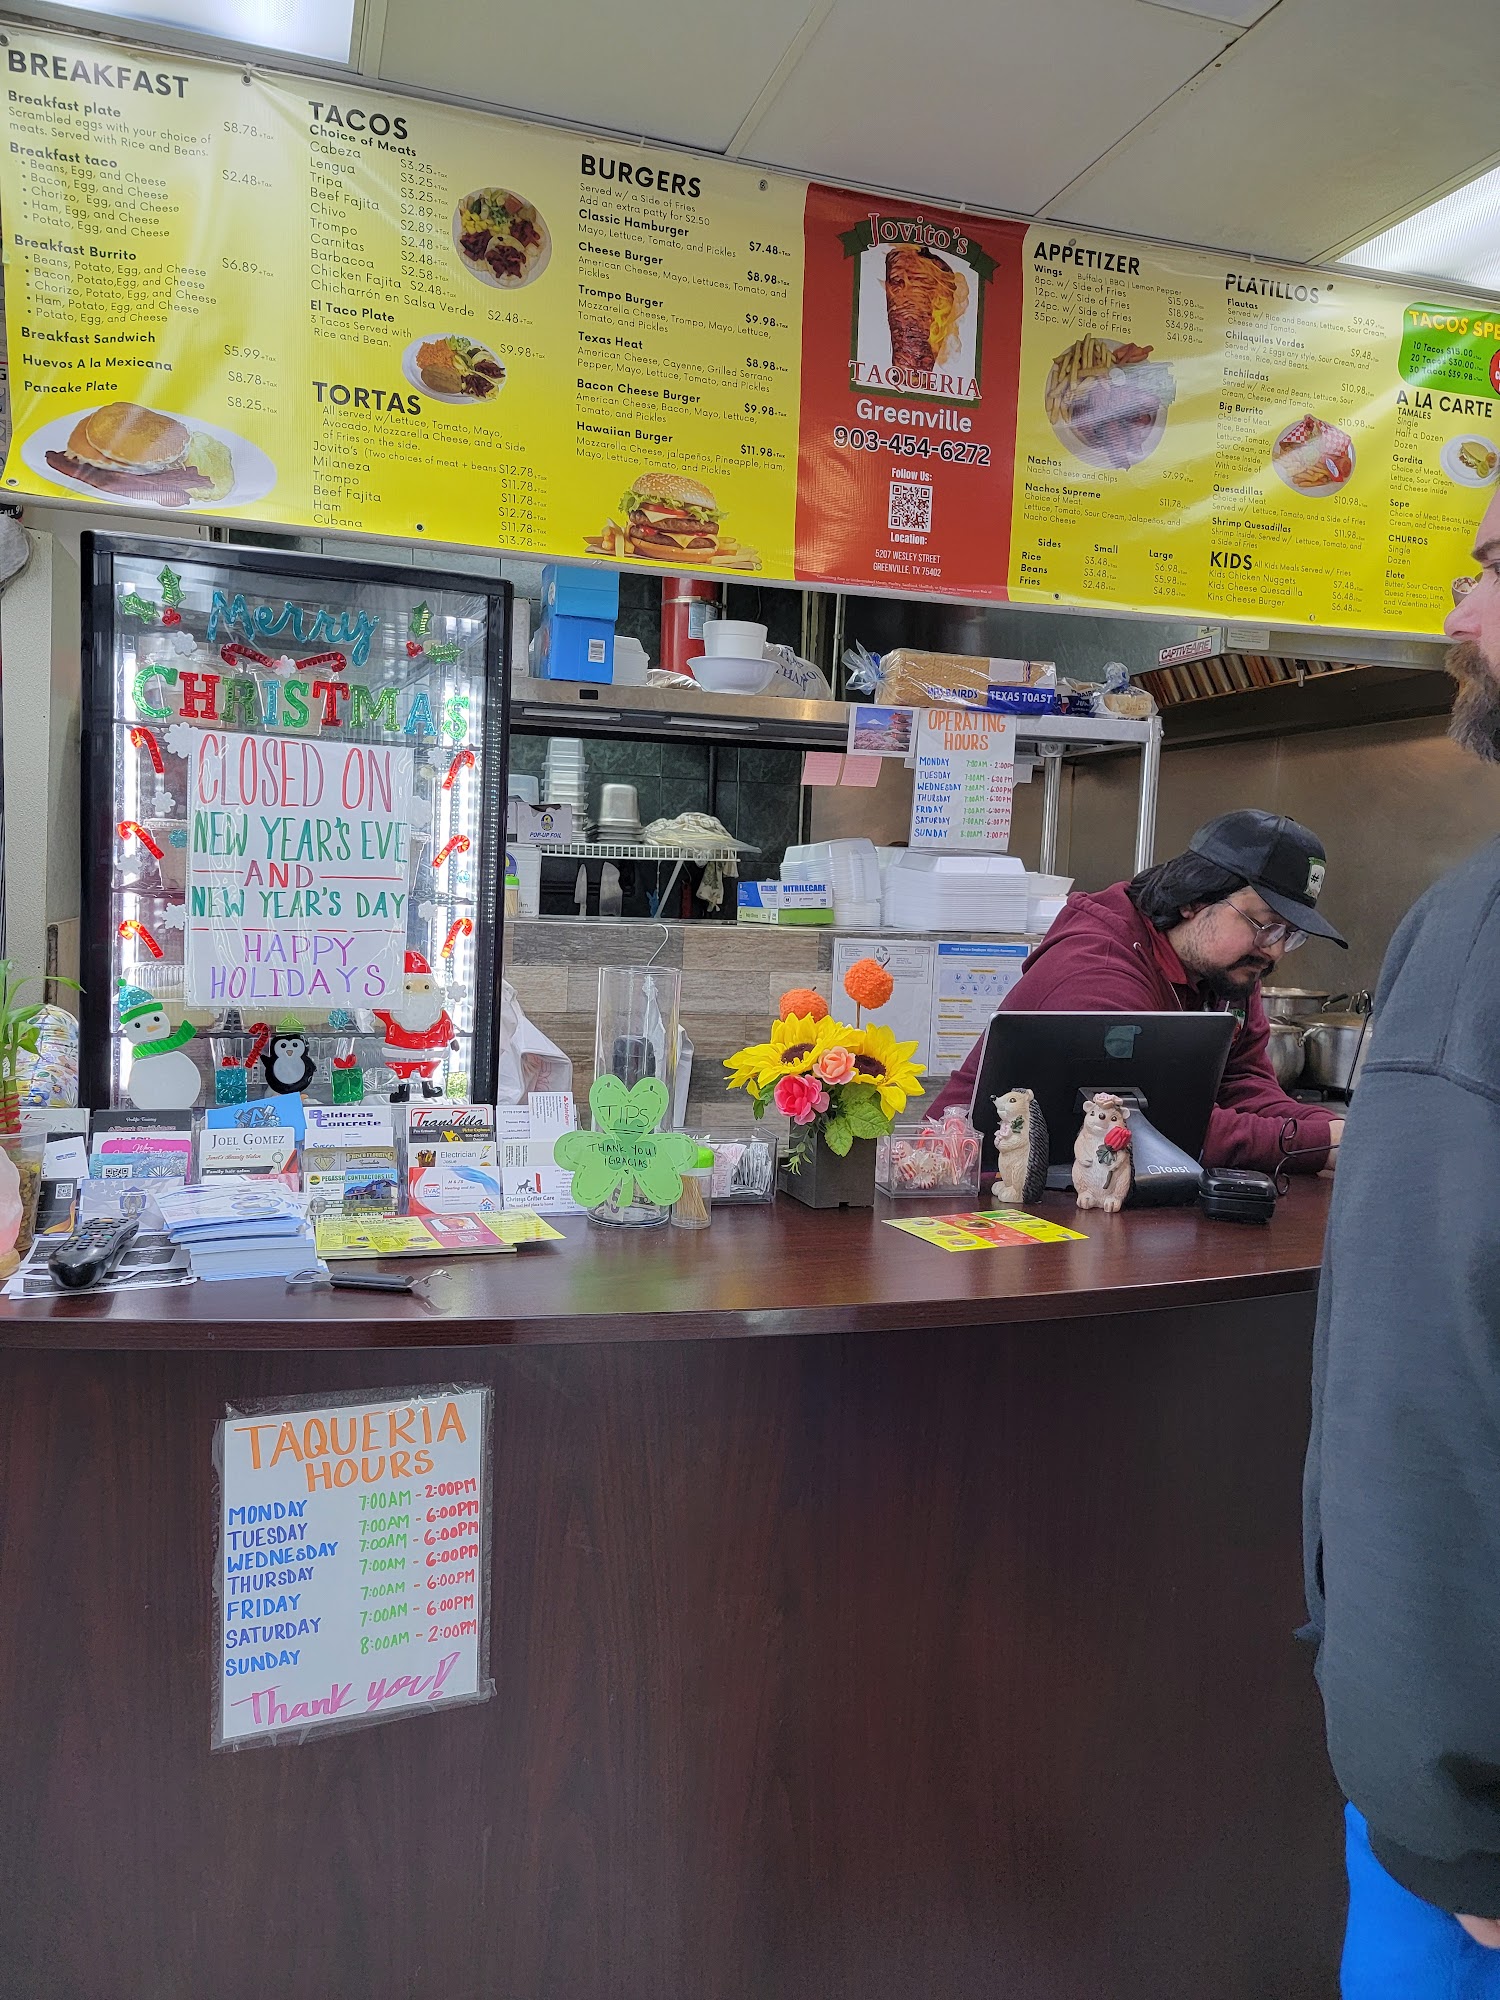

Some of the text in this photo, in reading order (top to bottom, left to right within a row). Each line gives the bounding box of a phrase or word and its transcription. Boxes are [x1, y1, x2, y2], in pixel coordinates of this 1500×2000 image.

[8, 50, 189, 98] BREAKFAST
[8, 90, 121, 118] Breakfast plate
[308, 101, 408, 139] TACOS
[310, 125, 416, 157] Choice of Meats
[310, 141, 362, 158] Cabeza
[10, 142, 118, 168] Breakfast taco
[310, 157, 356, 176] Lengua
[581, 154, 701, 198] BURGERS
[310, 172, 343, 188] Tripa
[310, 187, 380, 212] Beef Fajita
[310, 203, 346, 218] Chivo
[310, 218, 358, 236] Trompo
[578, 208, 689, 238] Classic Hamburger
[310, 234, 364, 252] Carnitas
[867, 212, 969, 255] Jovito's
[14, 234, 136, 261] Breakfast Burrito
[578, 242, 664, 266] Cheese Burger
[310, 249, 374, 269] Barbacoa
[1034, 242, 1140, 276] APPETIZER
[1034, 264, 1062, 277] Wings
[578, 284, 664, 308] Trompo Burger
[1225, 273, 1319, 304] PLATILLOS
[310, 300, 395, 322] El Taco Plate
[1228, 299, 1258, 310] Flautas
[1409, 310, 1469, 335] TACOS
[22, 327, 156, 344] Breakfast Sandwich
[578, 331, 643, 350] Texas Heat
[1226, 331, 1304, 349] Chilaquiles Verdes
[22, 354, 172, 371] Huevos A la Mexicana
[848, 360, 982, 399] TAQUERIA
[1224, 368, 1269, 382] Enchiladas
[24, 381, 118, 393] Pancake Plate
[577, 378, 701, 404] Bacon Cheese Burger
[312, 380, 422, 416] TORTAS
[1396, 390, 1492, 418] A LA CARTE
[856, 398, 972, 433] Greenville
[1219, 402, 1264, 416] Big Burrito
[1398, 408, 1432, 420] TAMALES
[576, 420, 673, 444] Hawaiian Burger
[313, 440, 358, 456] Jovito's
[834, 426, 990, 466] 903-454-6272
[313, 456, 370, 472] Milaneza
[1028, 455, 1062, 466] Nachos
[1392, 454, 1423, 464] Gordita
[892, 468, 932, 482] Follow Us:
[1026, 482, 1101, 500] Nachos Supreme
[1213, 484, 1263, 496] Quesadillas
[1390, 499, 1410, 509] Sope
[313, 514, 362, 528] Cubana
[1212, 518, 1291, 534] Shrimp Quesadillas
[890, 532, 928, 544] Location:
[1388, 534, 1428, 545] CHURROS
[876, 549, 940, 564] 5207 WESLEY STREET
[1022, 552, 1042, 561] Rice
[1038, 538, 1174, 561] Sides Small Large
[1020, 564, 1048, 574] Beans
[1210, 551, 1252, 570] KIDS
[912, 566, 920, 574] TX
[922, 567, 942, 576] 75402
[1386, 570, 1405, 579] Elote
[1020, 576, 1040, 586] Fries
[207, 590, 379, 667] Merry
[1162, 640, 1210, 660] CAPTIVEAIRE
[132, 664, 470, 740] CHRISTMAS
[990, 691, 1052, 704] TEXAS TOAST
[928, 710, 1006, 733] OPERATING
[944, 732, 988, 750] HOURS
[920, 757, 950, 766] MONDAY
[198, 734, 392, 812] CLOSED ON
[918, 771, 950, 780] TUESDAY
[917, 782, 962, 792] WEDNESDAY
[917, 794, 950, 803] THURSDAY
[916, 805, 943, 814] FRIDAY
[915, 816, 950, 825] SATURDAY
[193, 810, 408, 863] NEW YEAR'S EVE
[914, 828, 948, 838] SUNDAY
[244, 860, 314, 888] AND
[783, 884, 826, 892] NITRILECARE
[190, 886, 406, 919] NEW YEAR'S DAY
[244, 934, 356, 966] HAPPY
[210, 964, 386, 1000] HOLIDAYS
[308, 1110, 374, 1120] Balderas
[316, 1118, 382, 1128] Concrete
[598, 1105, 651, 1128] TIPS
[212, 1133, 284, 1149] JOEL GOMEZ
[588, 1143, 657, 1158] THANK YOU!
[440, 1150, 477, 1159] Electrician
[1160, 1164, 1190, 1174] toast
[234, 1402, 467, 1470] TAQUERIA
[304, 1450, 434, 1492] HOURS
[228, 1500, 308, 1526] MONDAY
[227, 1522, 308, 1550] TUESDAY
[228, 1542, 338, 1572] WEDNESDAY
[227, 1566, 314, 1595] THURSDAY
[227, 1594, 302, 1622] FRIDAY
[226, 1618, 321, 1648] SATURDAY
[226, 1650, 300, 1676] SUNDAY
[231, 1652, 461, 1726] Thank you!
